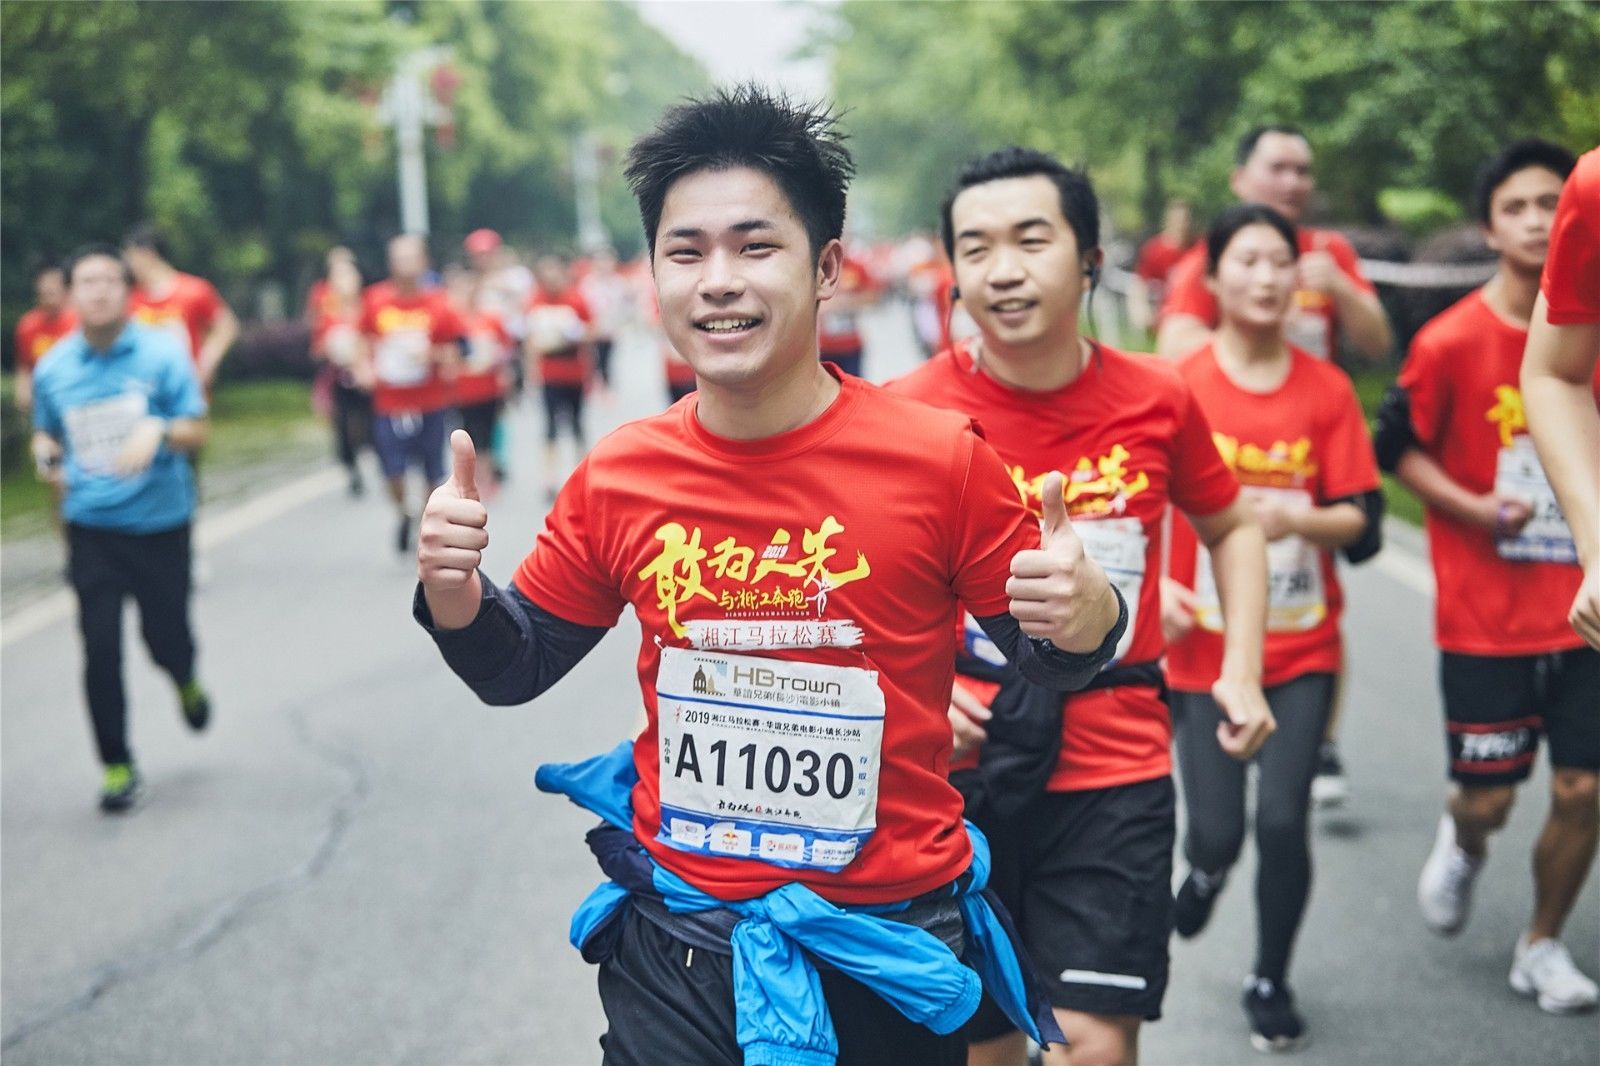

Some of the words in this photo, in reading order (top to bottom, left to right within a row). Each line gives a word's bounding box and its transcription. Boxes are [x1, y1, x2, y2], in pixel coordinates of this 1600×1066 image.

[718, 585, 809, 611] 与湘江奔跑
[700, 623, 838, 648] 湘江马拉松赛
[685, 710, 710, 725] 2019
[674, 733, 854, 799] A11030
